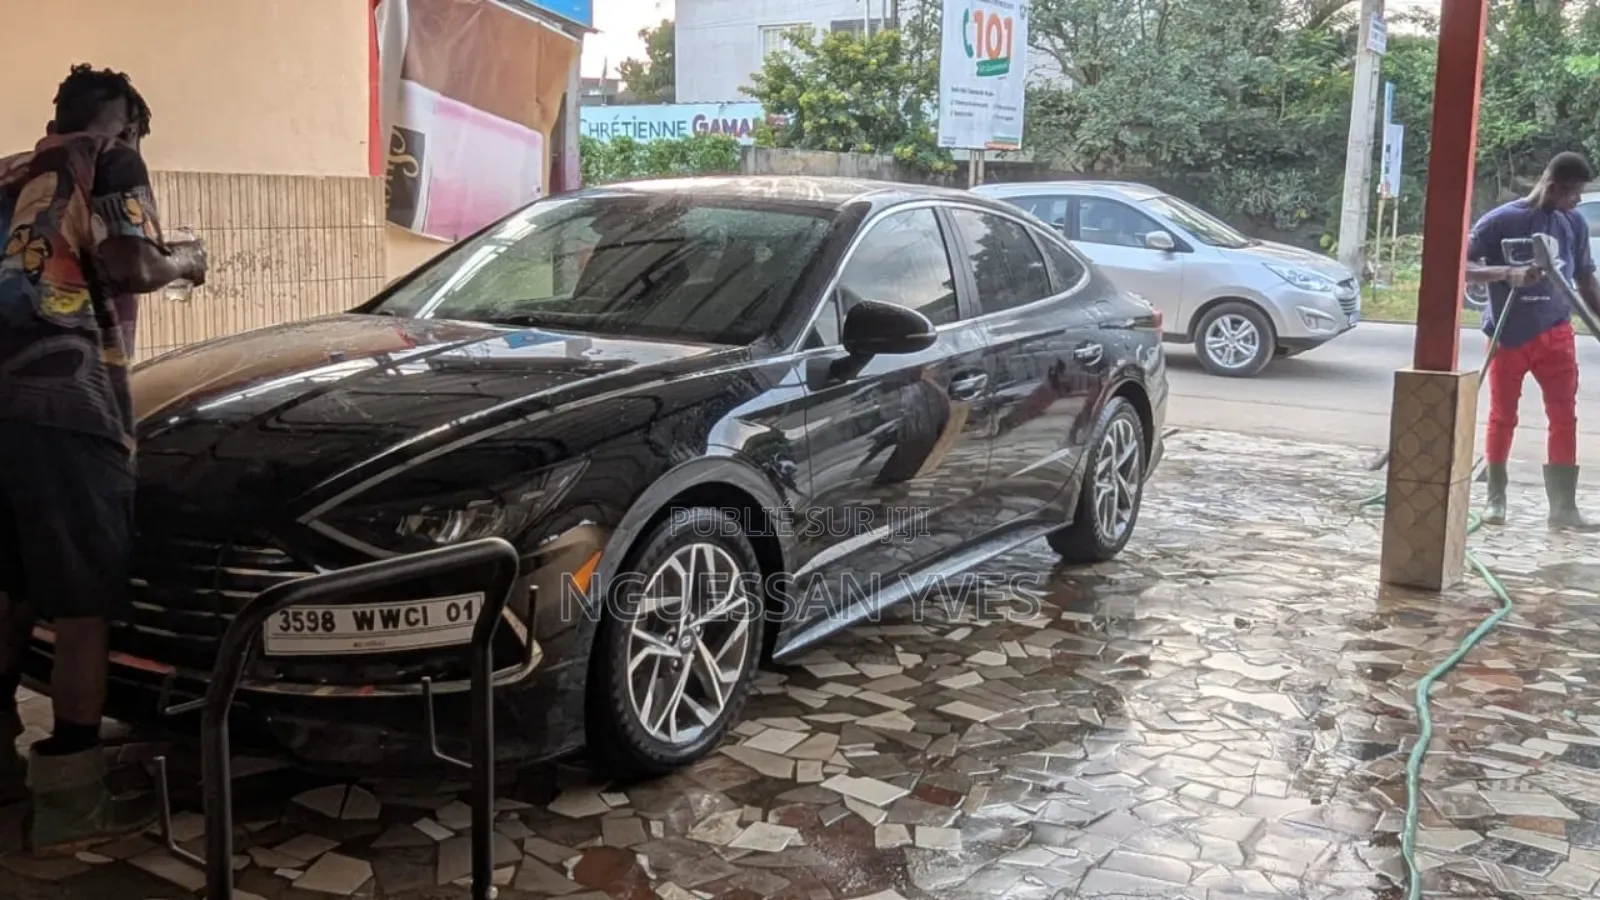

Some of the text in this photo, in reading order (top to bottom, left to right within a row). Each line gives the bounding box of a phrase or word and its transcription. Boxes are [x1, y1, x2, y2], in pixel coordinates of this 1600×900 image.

[972, 8, 1013, 60] 101
[279, 600, 474, 633] 3598 WWCI 01
